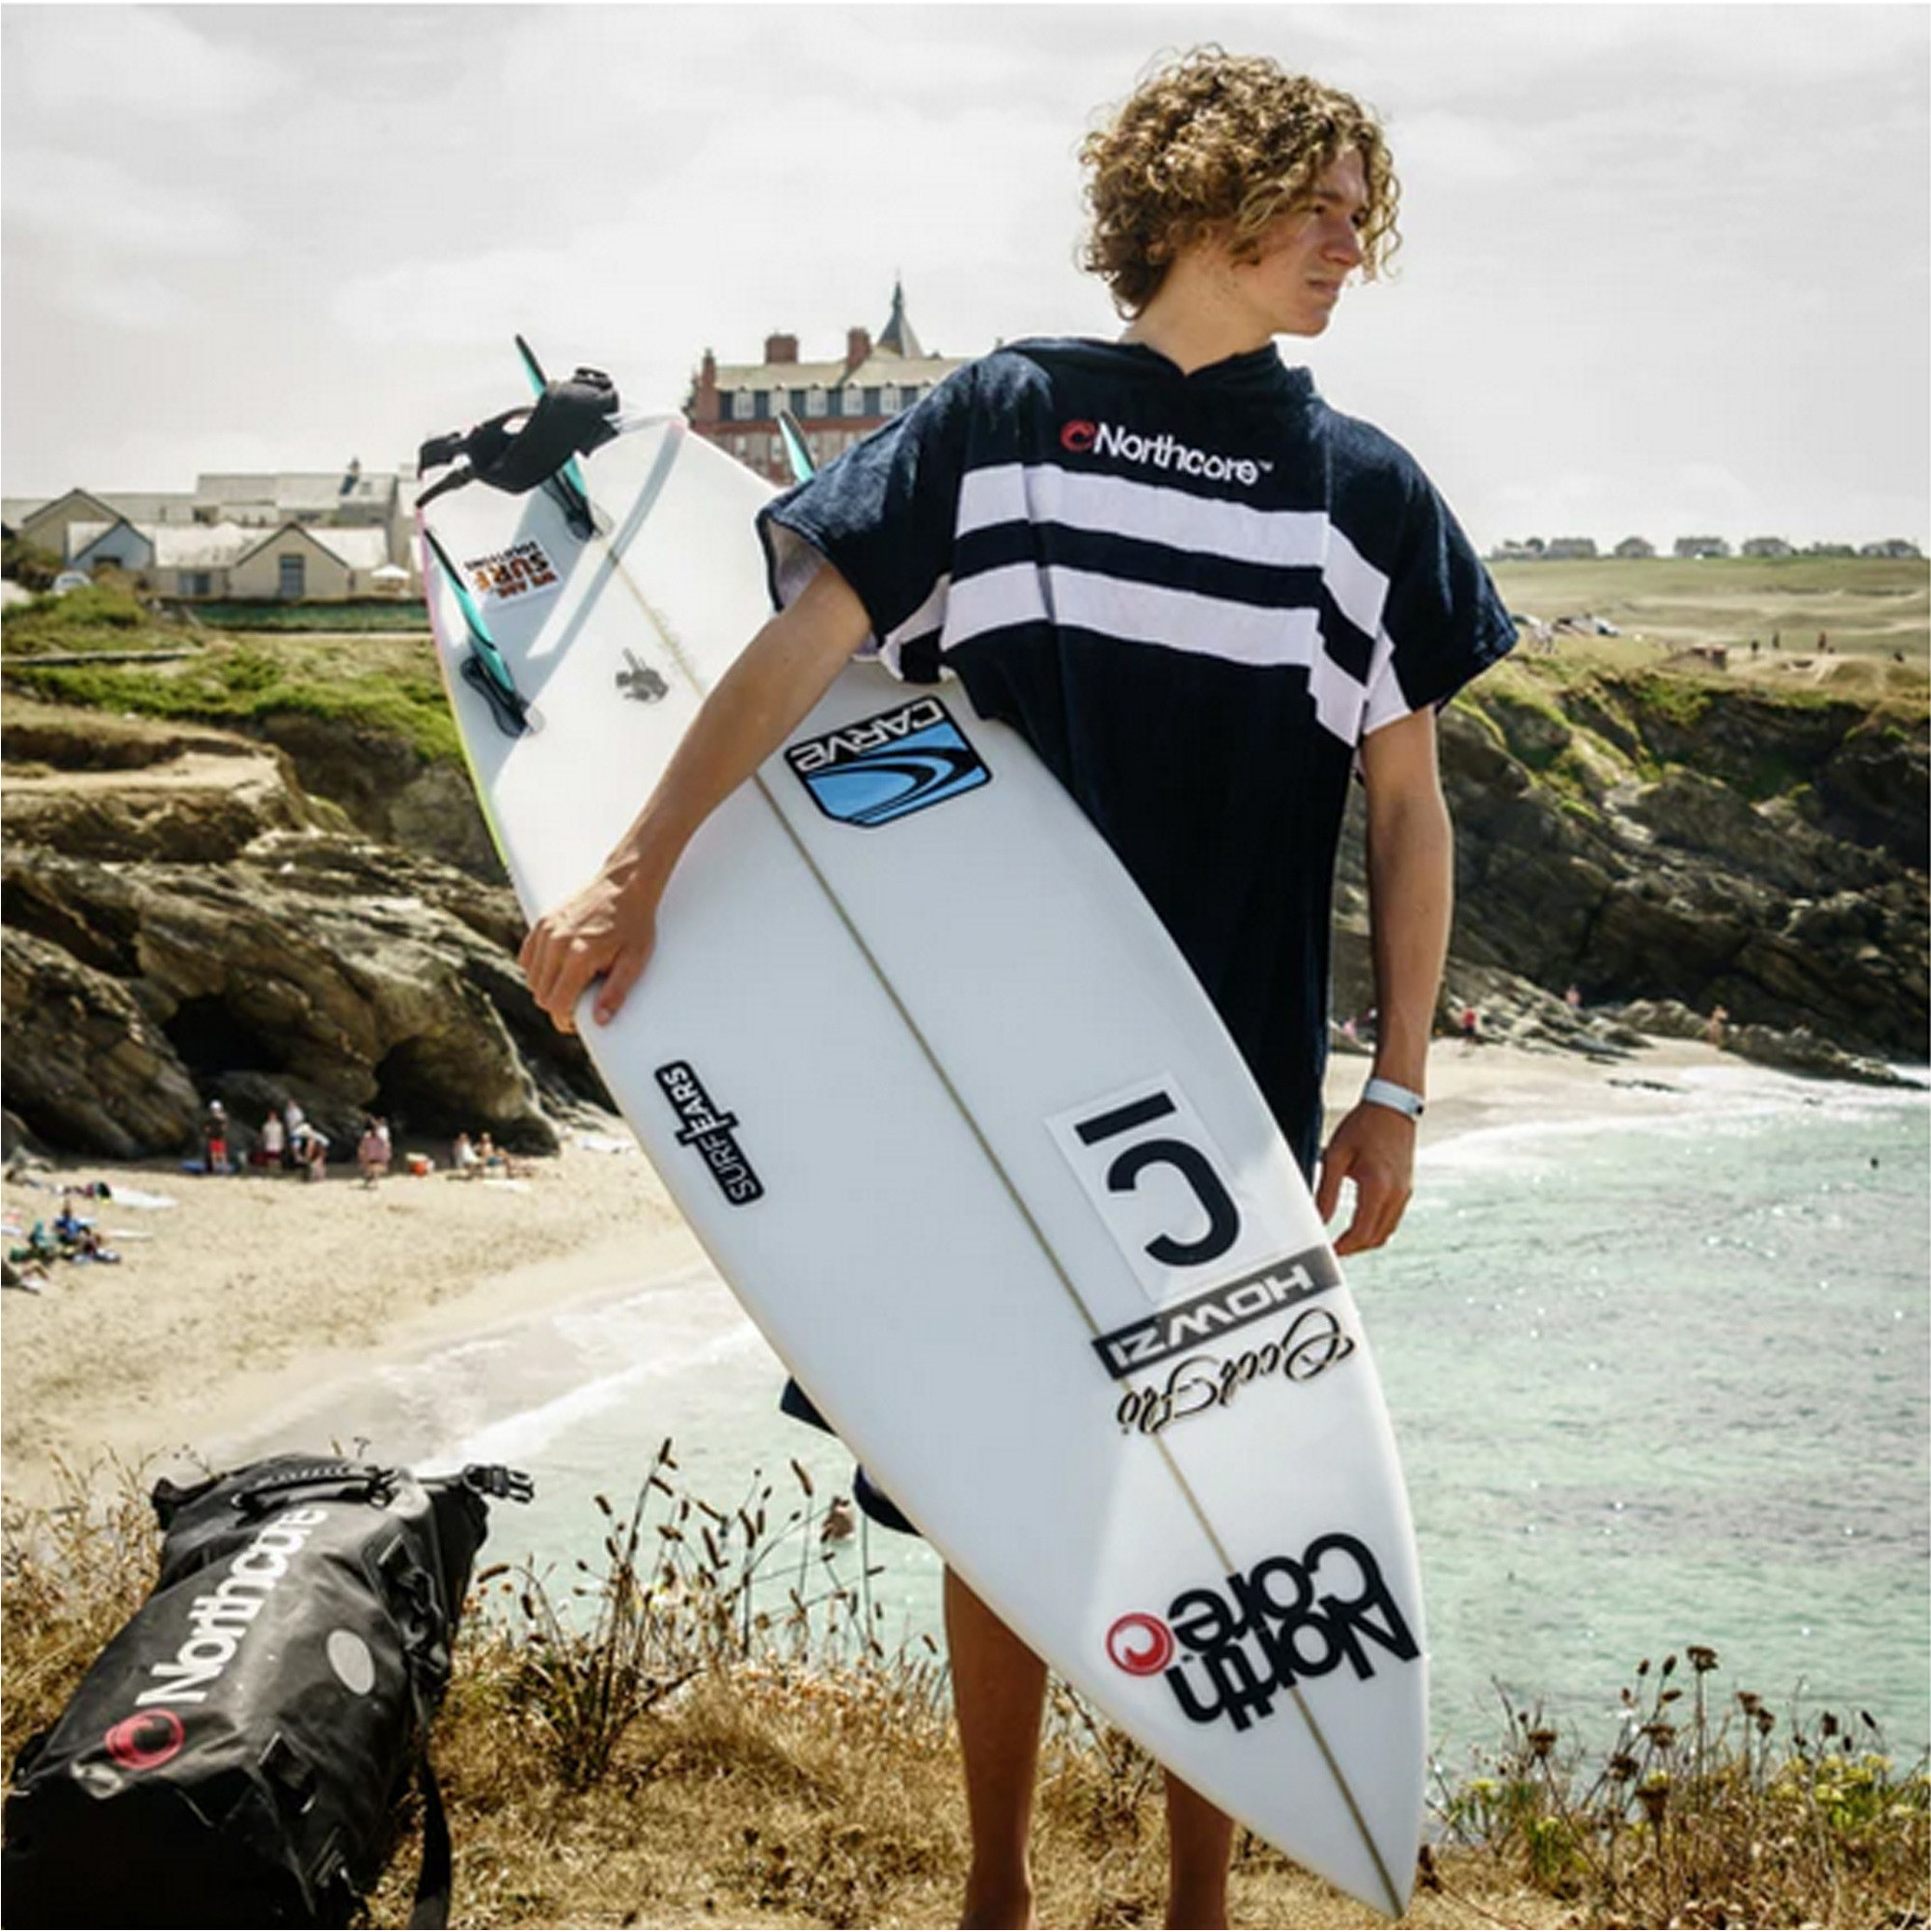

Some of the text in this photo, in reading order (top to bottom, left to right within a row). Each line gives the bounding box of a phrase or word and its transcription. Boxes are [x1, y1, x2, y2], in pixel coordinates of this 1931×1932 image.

[1093, 422, 1258, 485] Northcore
[474, 549, 549, 592] SURF
[790, 699, 944, 772] CARVE
[1109, 1264, 1313, 1366] HOWZI
[135, 1508, 328, 1706] Northcore
[1167, 1532, 1383, 1652] Core
[1164, 1592, 1421, 1733] North
